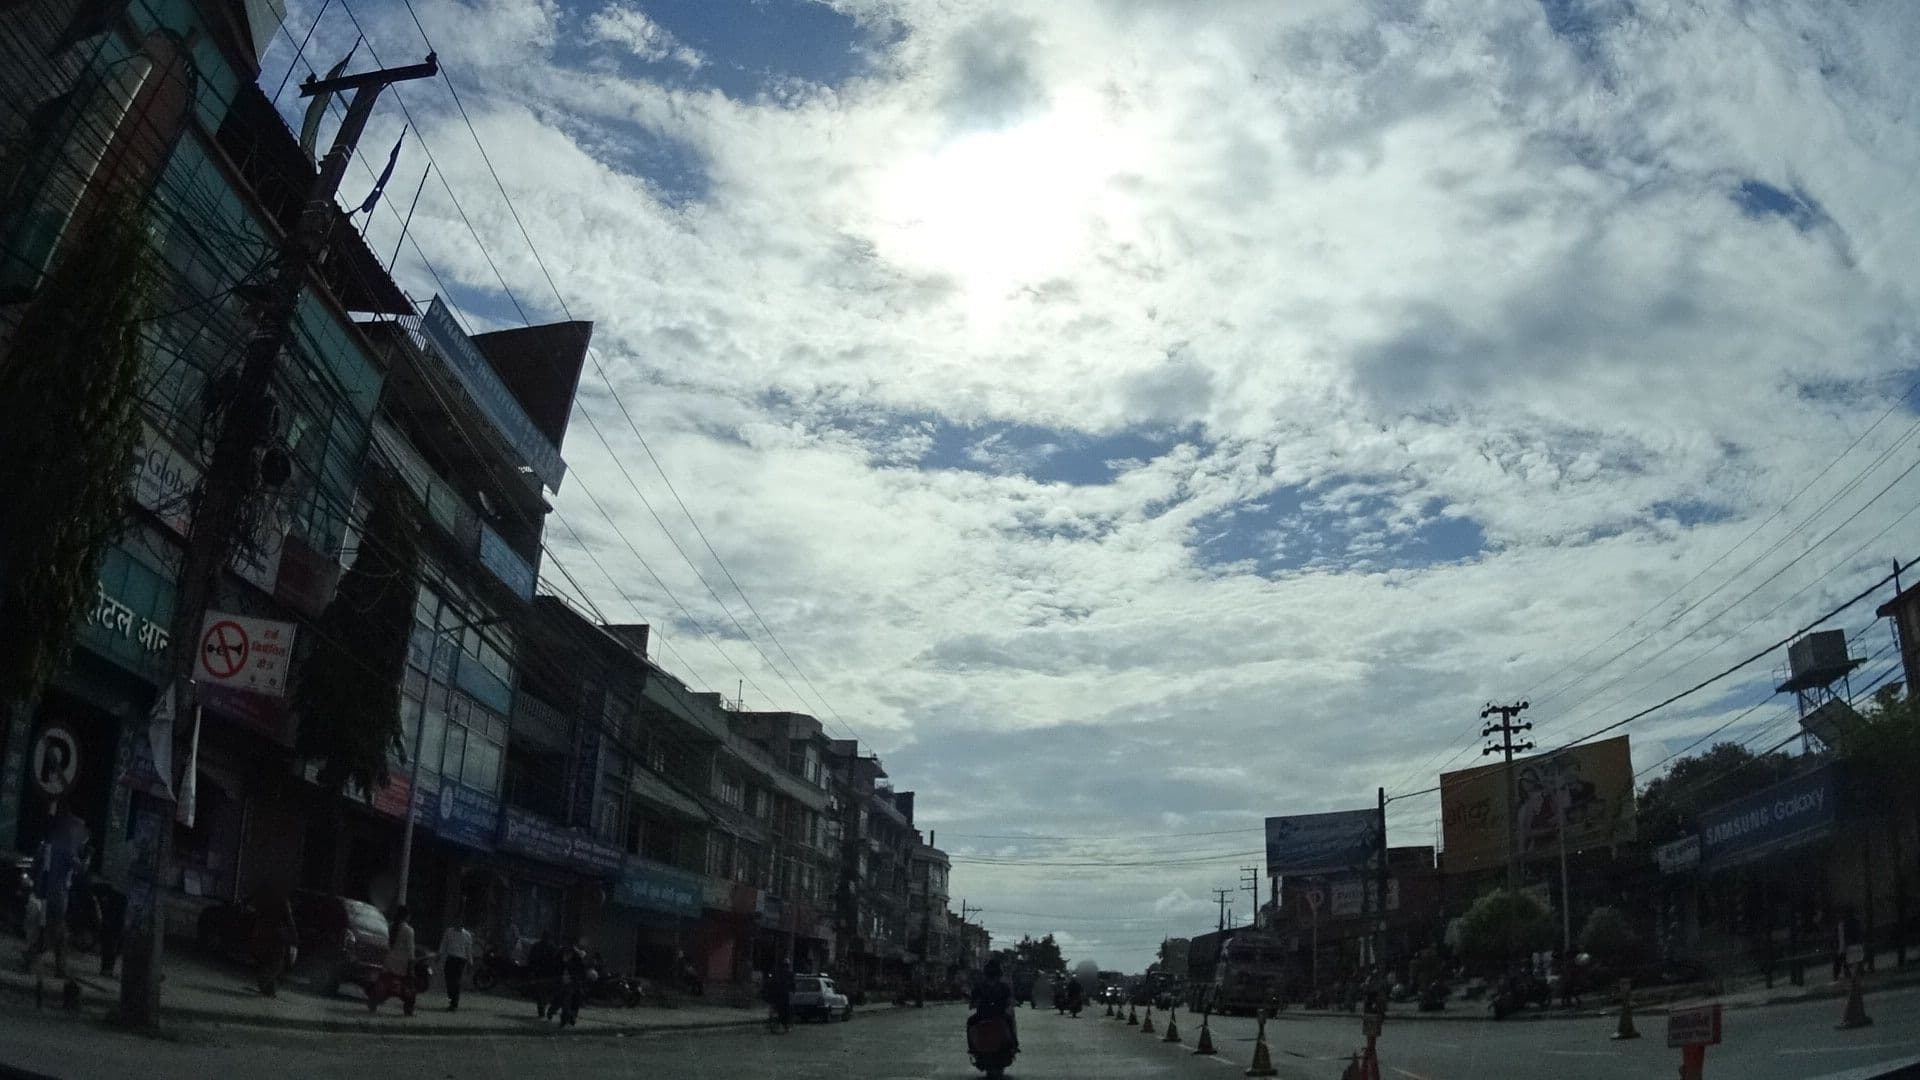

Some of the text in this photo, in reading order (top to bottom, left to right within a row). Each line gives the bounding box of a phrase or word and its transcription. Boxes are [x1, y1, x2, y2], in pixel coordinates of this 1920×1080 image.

[431, 301, 477, 367] DYNAMIC
[149, 449, 191, 493] Glob
[1705, 787, 1824, 845] SAMSUNG Galaxy
